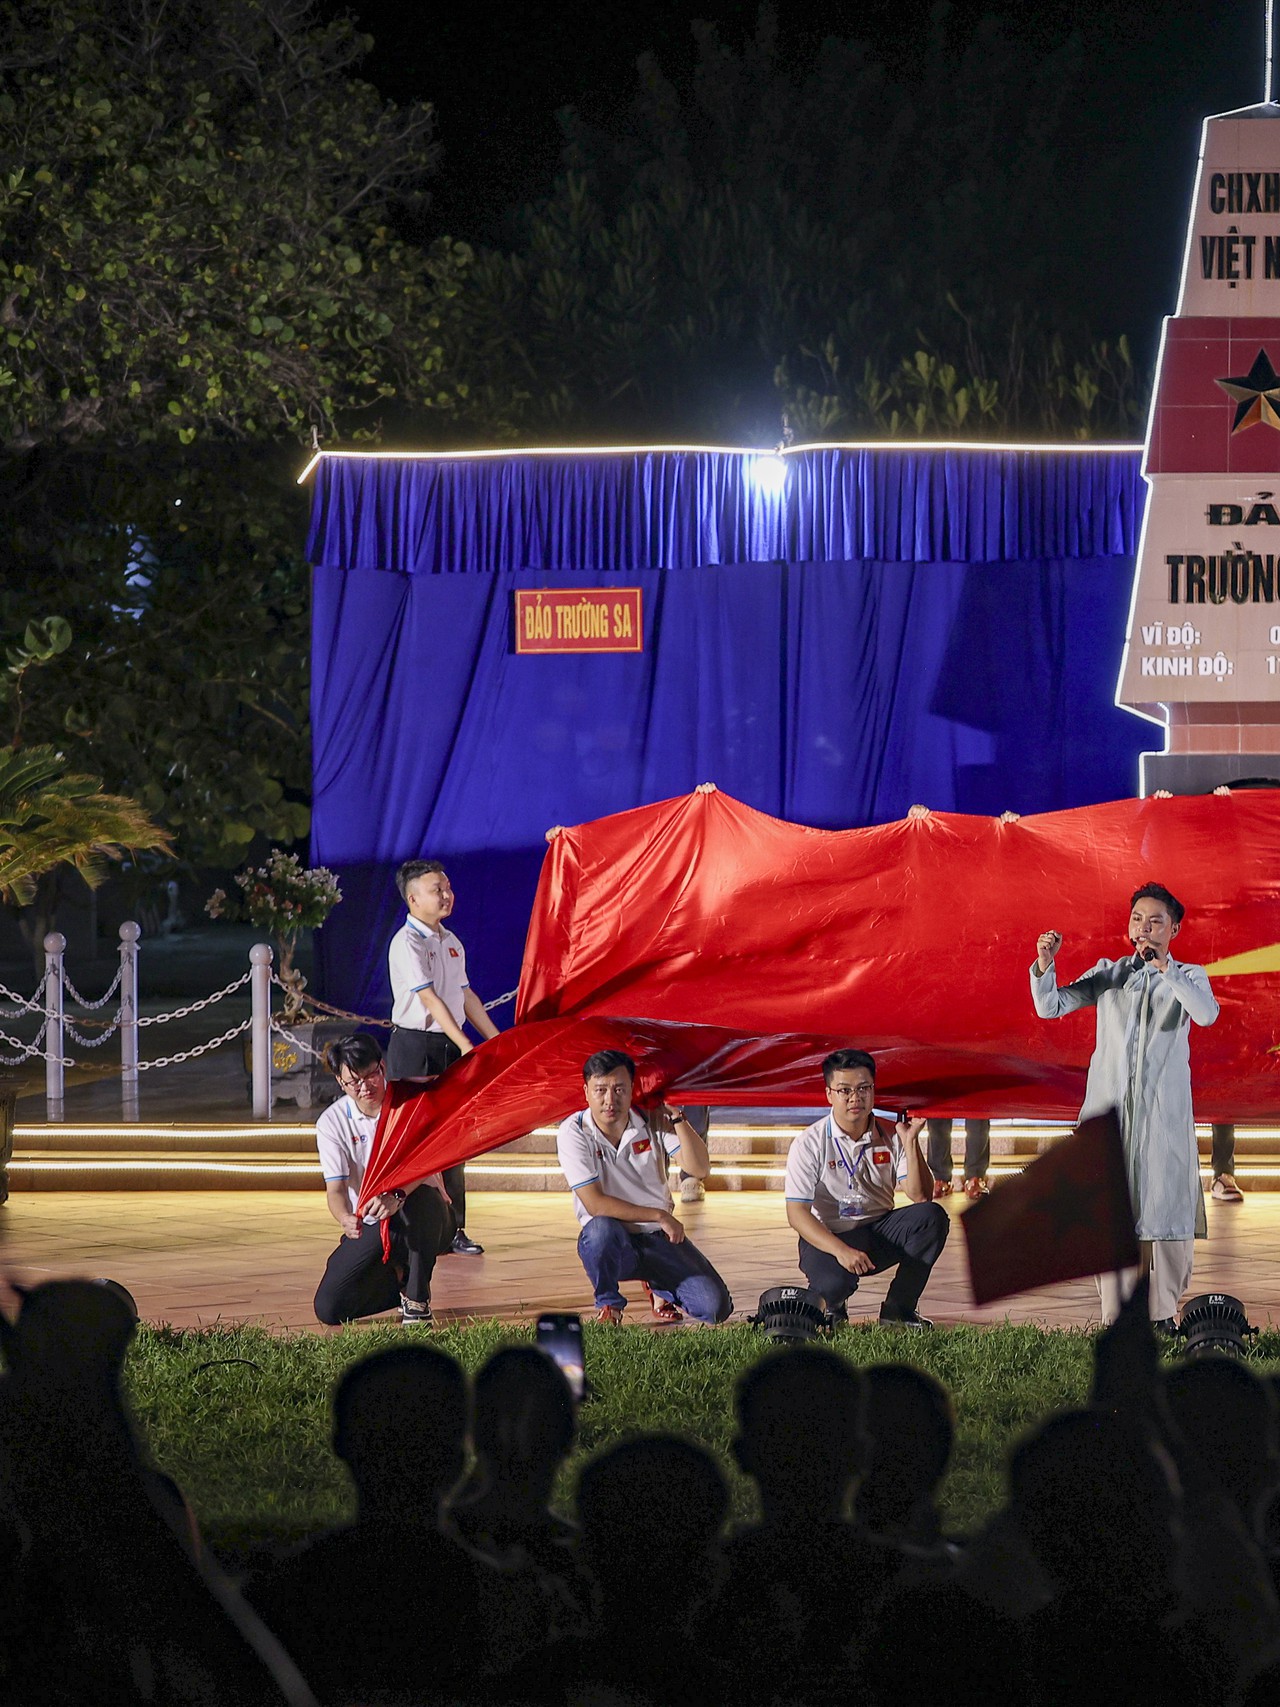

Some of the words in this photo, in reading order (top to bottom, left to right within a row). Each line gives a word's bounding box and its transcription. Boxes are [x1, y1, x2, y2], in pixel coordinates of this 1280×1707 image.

[1200, 226, 1256, 289] VIỆT
[525, 594, 552, 640] ĐẢO
[555, 597, 609, 639] TRƯỜNG
[613, 603, 632, 638] SA
[1141, 621, 1164, 646] VĨ
[1166, 621, 1202, 650] ĐỘ:
[1141, 656, 1193, 676] KINH
[1198, 651, 1234, 682] ĐỘ:
